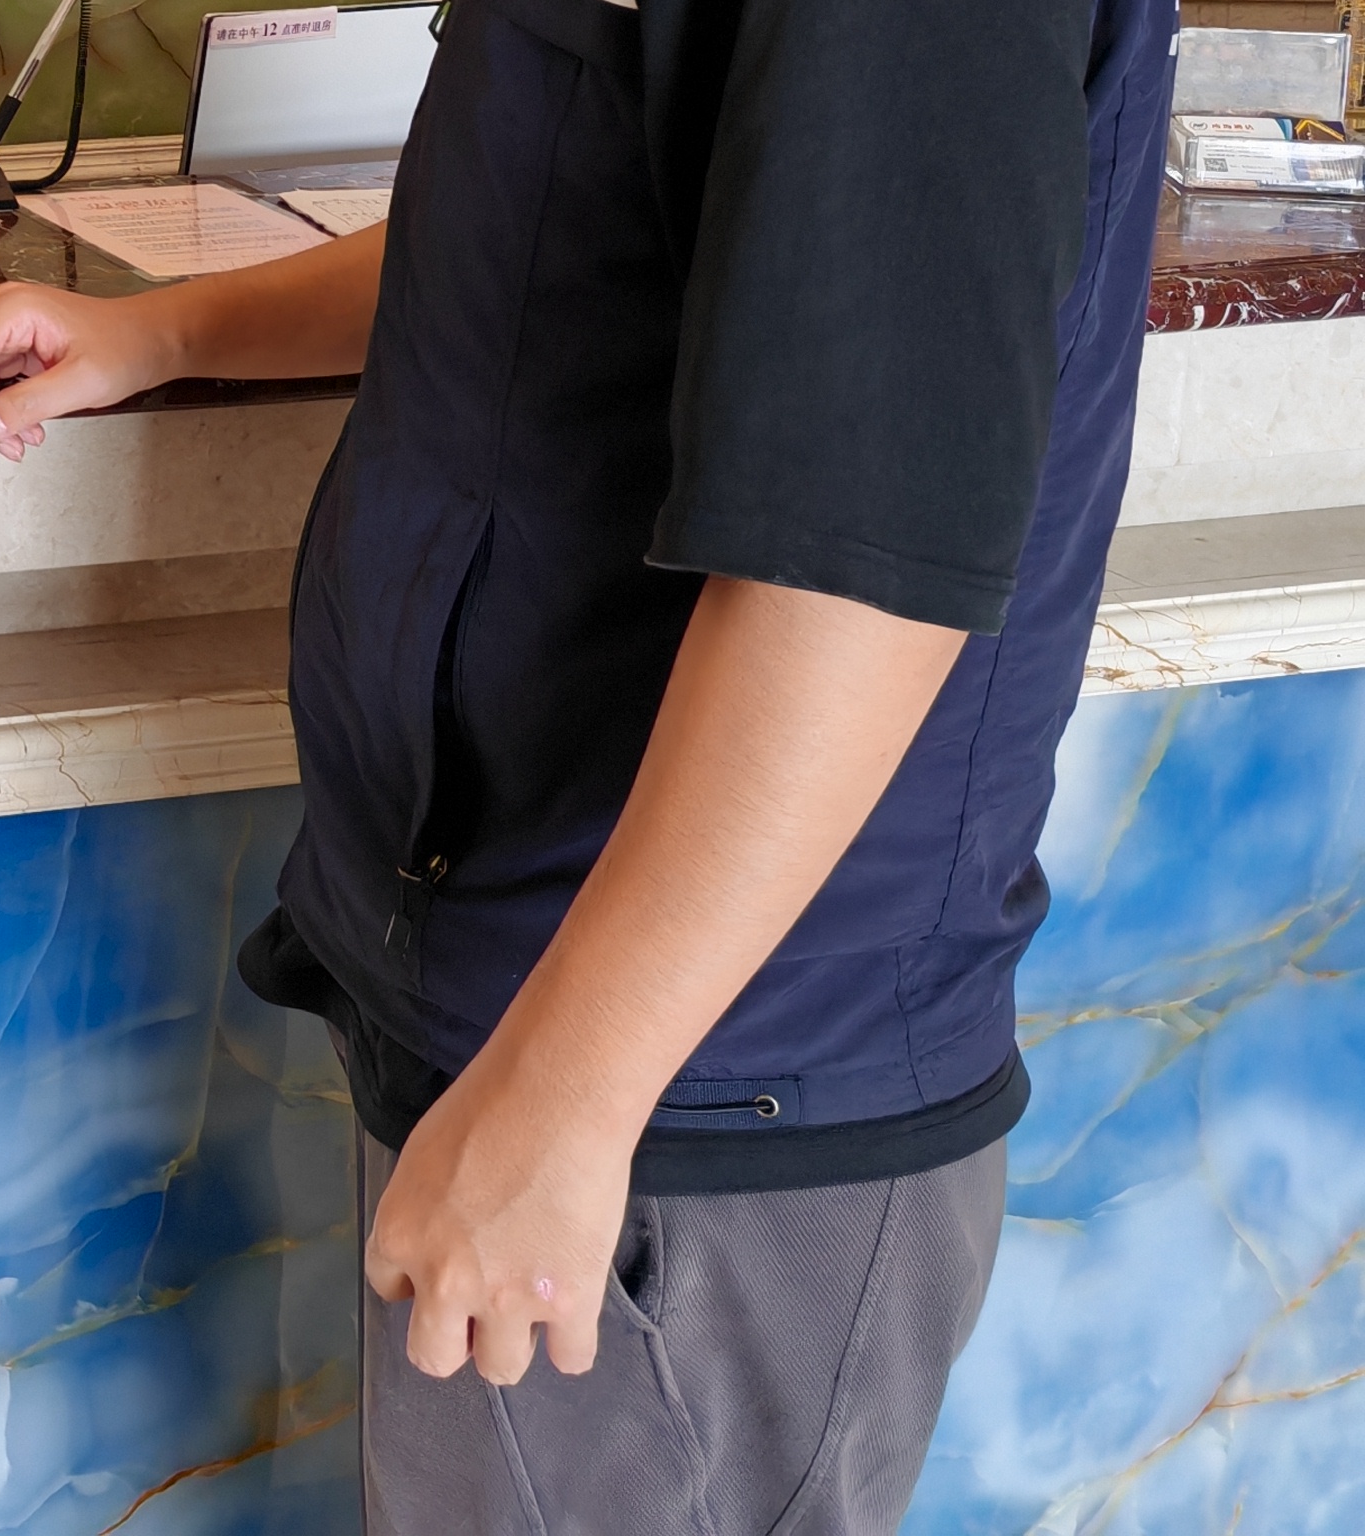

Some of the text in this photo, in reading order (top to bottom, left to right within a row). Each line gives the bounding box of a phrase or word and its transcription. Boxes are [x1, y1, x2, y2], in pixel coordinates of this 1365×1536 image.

[216, 19, 332, 41] 请在中午 12 点准时退房
